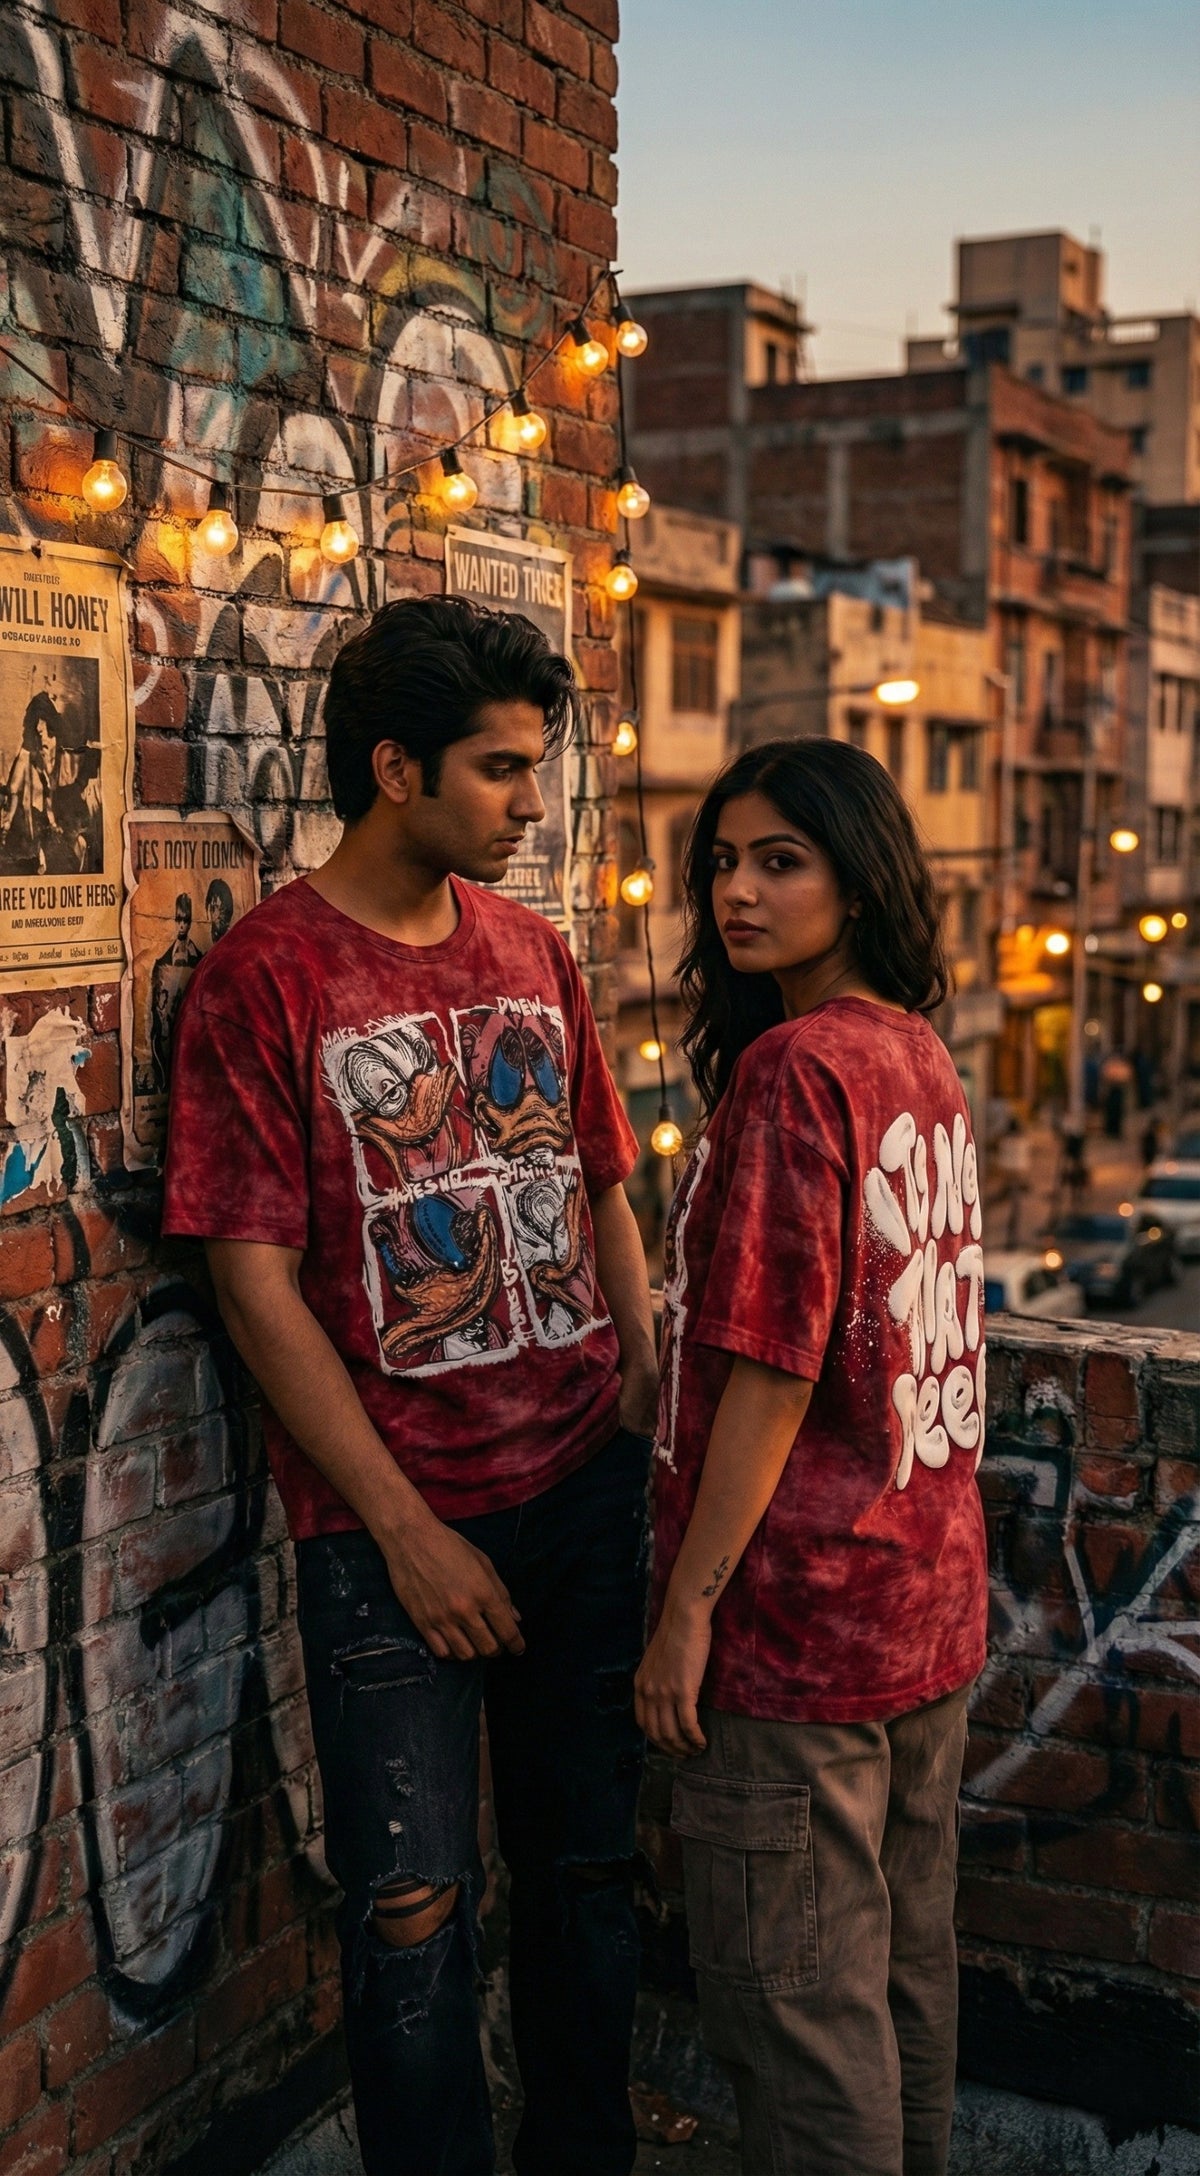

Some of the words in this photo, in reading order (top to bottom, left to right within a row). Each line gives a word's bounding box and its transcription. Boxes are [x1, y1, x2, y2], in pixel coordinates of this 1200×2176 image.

[454, 552, 519, 600] WANTED
[0, 586, 44, 626] WILL
[50, 592, 109, 633] HONEY
[60, 885, 82, 909] ONE
[86, 884, 116, 907] HERS
